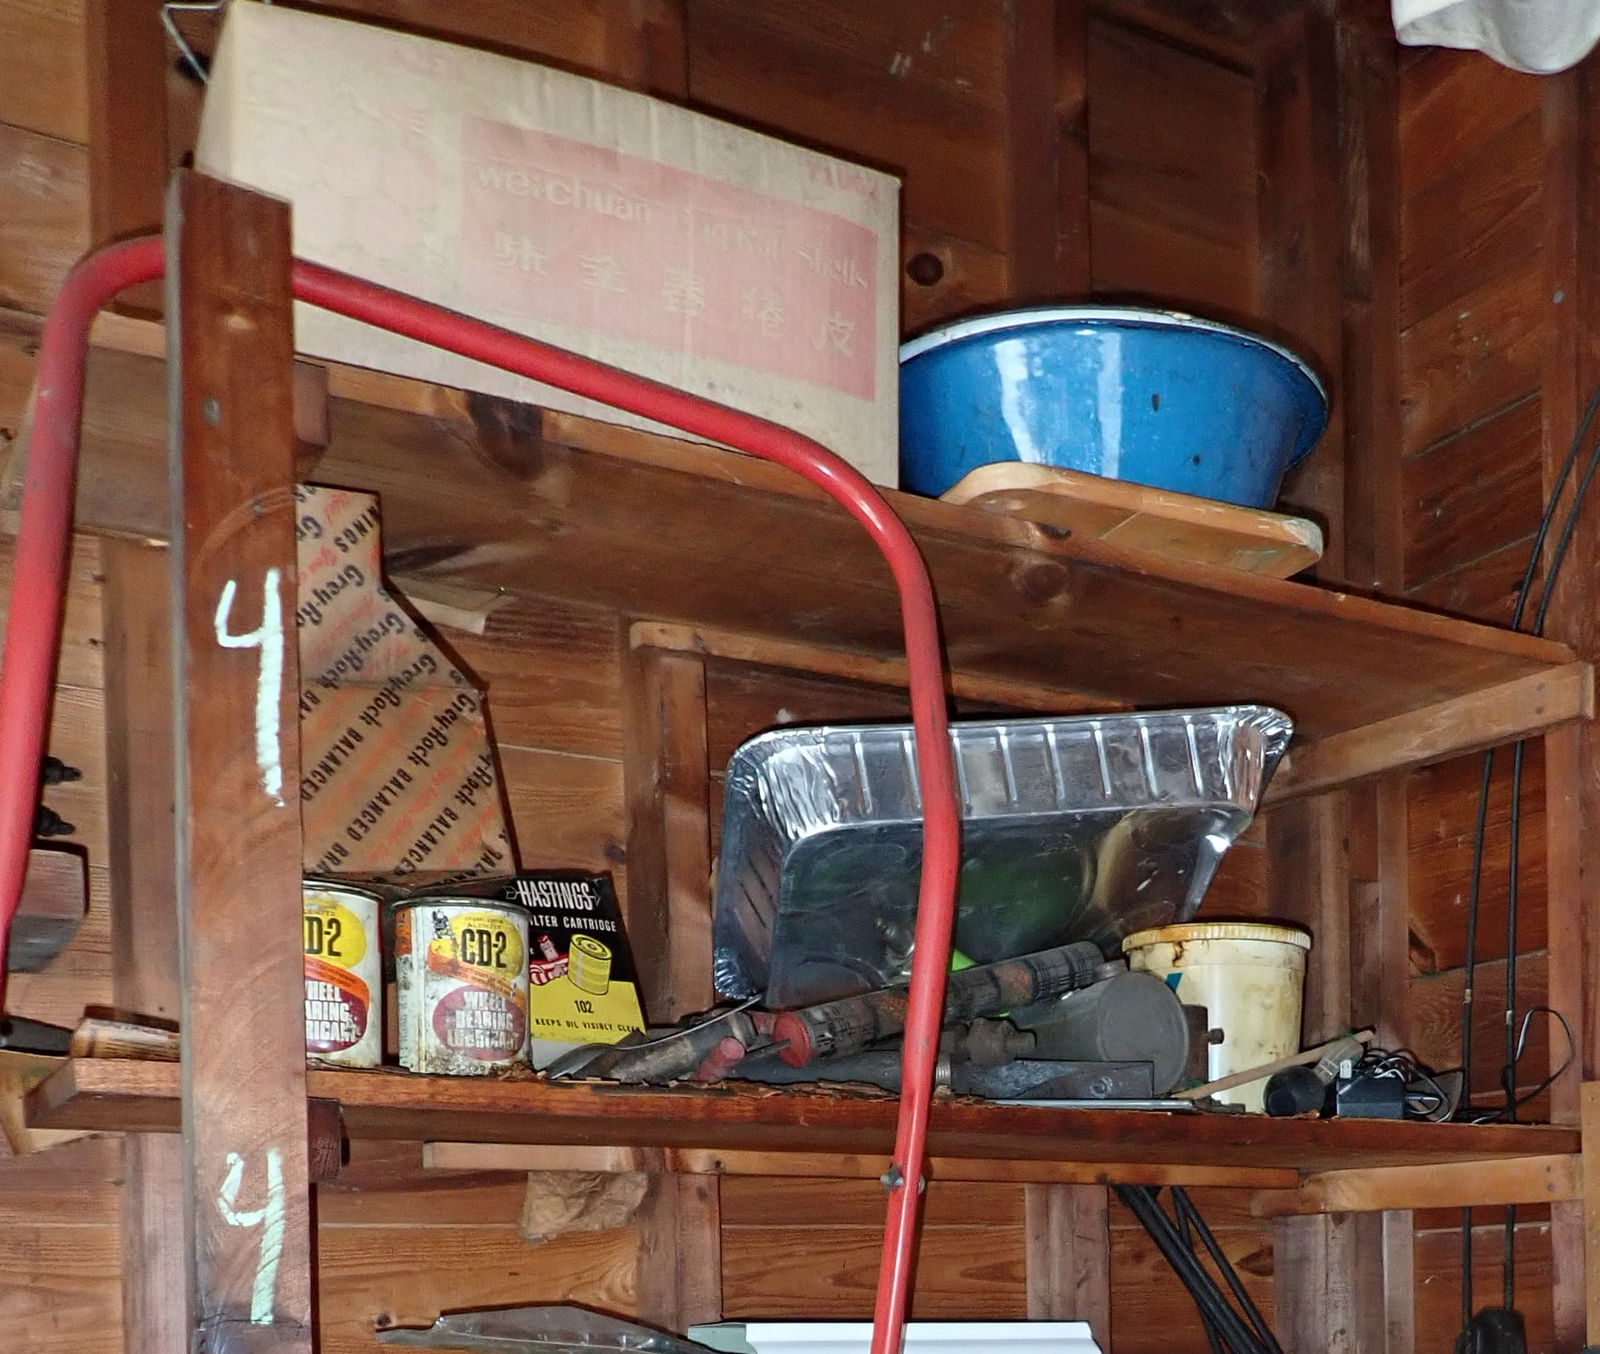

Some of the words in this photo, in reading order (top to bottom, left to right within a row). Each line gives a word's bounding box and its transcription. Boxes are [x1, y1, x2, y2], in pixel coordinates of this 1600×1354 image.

[214, 566, 285, 807] 4
[345, 767, 414, 843] BALANCED
[516, 879, 594, 911] HASTINGS
[303, 915, 342, 958] D-2
[530, 913, 559, 928] ILTER
[563, 916, 617, 933] CARTRIDGE
[461, 928, 508, 969] CD-2
[574, 1000, 594, 1014] 102
[217, 1147, 287, 1326] 4
